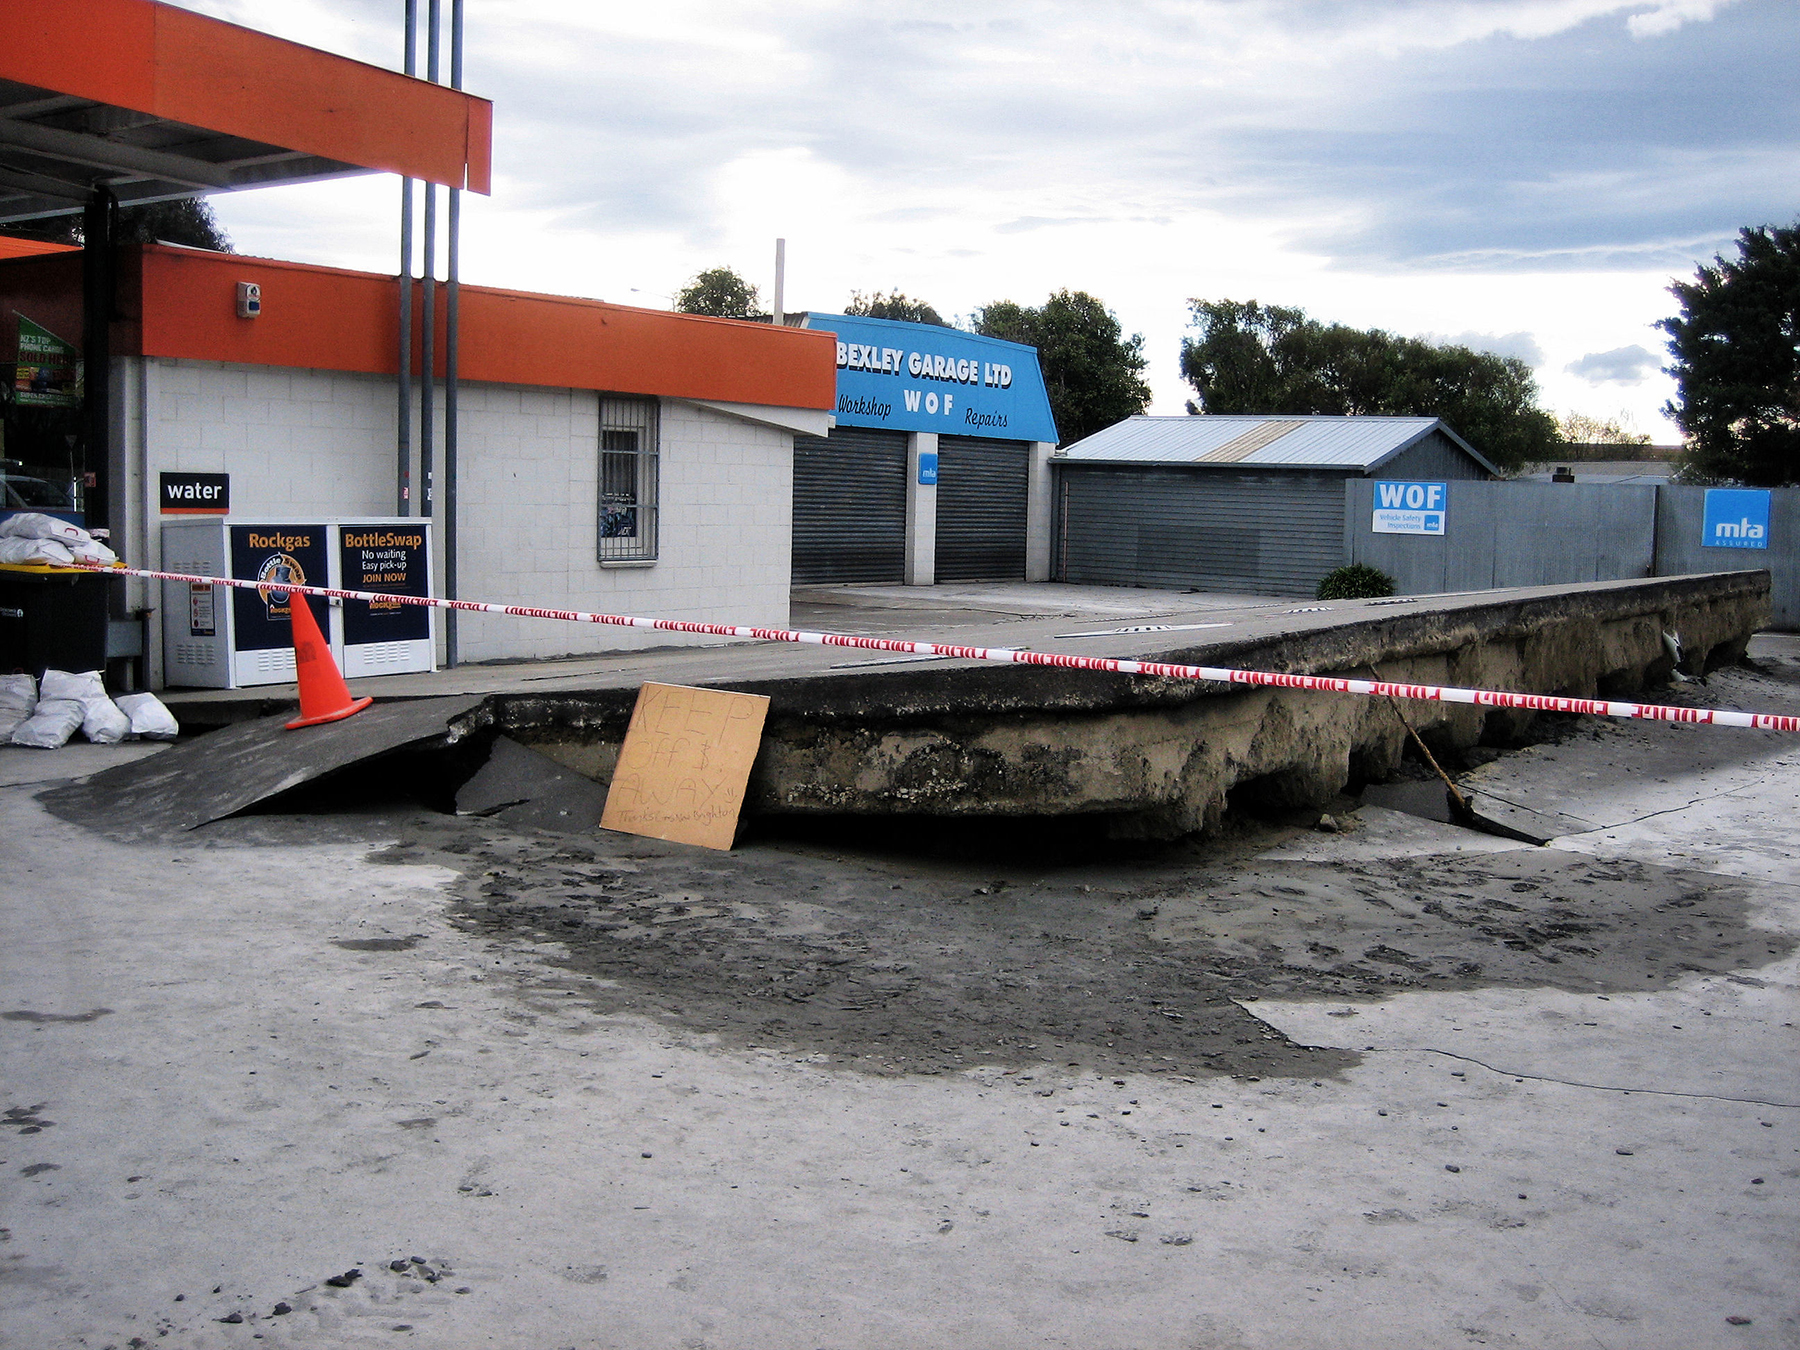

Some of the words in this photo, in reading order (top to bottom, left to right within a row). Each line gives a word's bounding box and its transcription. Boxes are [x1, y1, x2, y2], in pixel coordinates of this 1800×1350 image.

[19, 350, 46, 363] SOLD
[836, 341, 904, 376] BEXLEY
[908, 351, 979, 385] GARAGE
[984, 362, 1013, 389] LTD
[837, 393, 893, 421] Workshop
[964, 407, 1009, 430] Repairs
[167, 483, 223, 500] water
[1378, 483, 1443, 509] WOF
[1379, 514, 1401, 522] Vehicle
[1402, 514, 1422, 523] Safety
[1386, 522, 1421, 531] Inspections
[1715, 517, 1764, 539] mta
[248, 532, 312, 552] Rockgas
[345, 532, 423, 551] BottleSwap
[1714, 539, 1764, 548] ASSURED
[361, 550, 375, 560] No
[376, 549, 407, 561] waiting
[260, 557, 282, 580] Bottle
[284, 558, 302, 580] Swap
[361, 561, 378, 573] Easy
[379, 560, 407, 572] pick-up
[362, 573, 382, 584] JOIN
[384, 572, 407, 583] NOW
[635, 685, 755, 747] KEEP
[615, 773, 729, 812] AWAY
